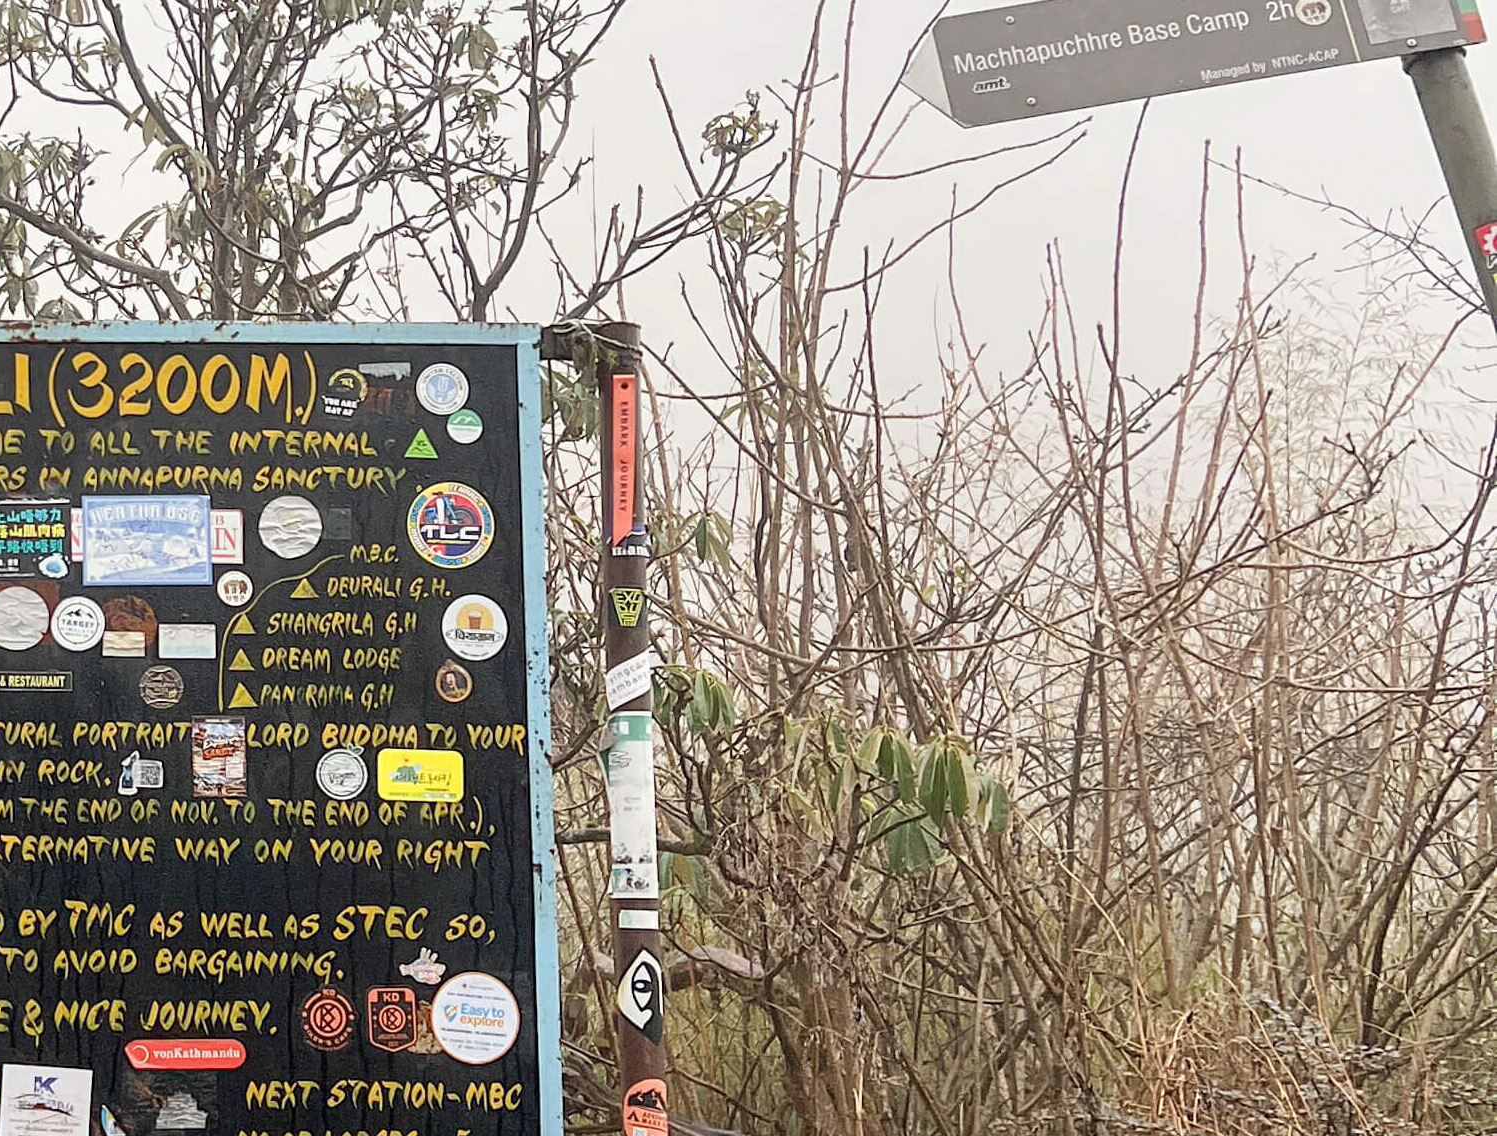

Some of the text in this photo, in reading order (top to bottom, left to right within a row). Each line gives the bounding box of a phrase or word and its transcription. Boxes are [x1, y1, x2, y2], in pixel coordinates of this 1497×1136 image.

[953, 30, 1123, 74] Machhapuchhre
[1127, 24, 1181, 45] Base
[1186, 10, 1250, 35] Camp
[1201, 48, 1339, 82] Managed by NTNC-ACAP
[40, 429, 74, 454] TO
[89, 431, 138, 455] ALL
[151, 429, 211, 454] THE
[229, 429, 378, 456] INTERNAL
[619, 401, 629, 512] EMBARK JOURNEY
[38, 467, 71, 488] IN
[82, 465, 243, 488] ANNAPURNA
[251, 467, 407, 495] SANCTURY
[420, 524, 482, 541] TLC
[327, 575, 402, 598] DEURALI
[62, 619, 95, 628] TARGET
[266, 612, 373, 636] SHANGRILA
[262, 647, 400, 670] DREAM LODGE
[0, 675, 6, 687] &
[8, 675, 66, 688] RESTAURANT
[72, 720, 192, 751] PORTRAIT
[246, 724, 310, 748] LORD
[321, 722, 419, 750] BUDDHA
[425, 724, 456, 750] TO
[466, 724, 526, 755] YOUR
[37, 760, 112, 787] ROCK.
[20, 798, 67, 823] THE
[76, 798, 122, 822] END
[130, 798, 161, 824] OF
[170, 798, 219, 825] NOV.
[223, 797, 257, 824] TO
[267, 798, 317, 826] THE
[324, 800, 369, 827] END
[378, 801, 408, 825] OF
[175, 837, 241, 861] WAY
[254, 839, 293, 863] ON
[309, 838, 383, 865] YOUR
[396, 838, 492, 874] RIGHT
[18, 908, 58, 937] BY
[64, 900, 136, 936] TMC
[149, 910, 184, 938] AS
[200, 912, 272, 939] WELL
[283, 913, 320, 939] AS
[332, 904, 429, 941] STEC
[444, 912, 498, 945] SO,
[53, 948, 138, 977] AVOID
[154, 948, 344, 986] BARGAINING.
[383, 992, 400, 1003] KD
[460, 1003, 505, 1018] Easy to
[22, 999, 44, 1046] &
[54, 999, 126, 1031] NICE
[142, 1000, 277, 1035] JOURNEY.
[459, 1016, 505, 1029] explore
[153, 1047, 241, 1061] vonKathmandu
[245, 1080, 318, 1110] NEXT
